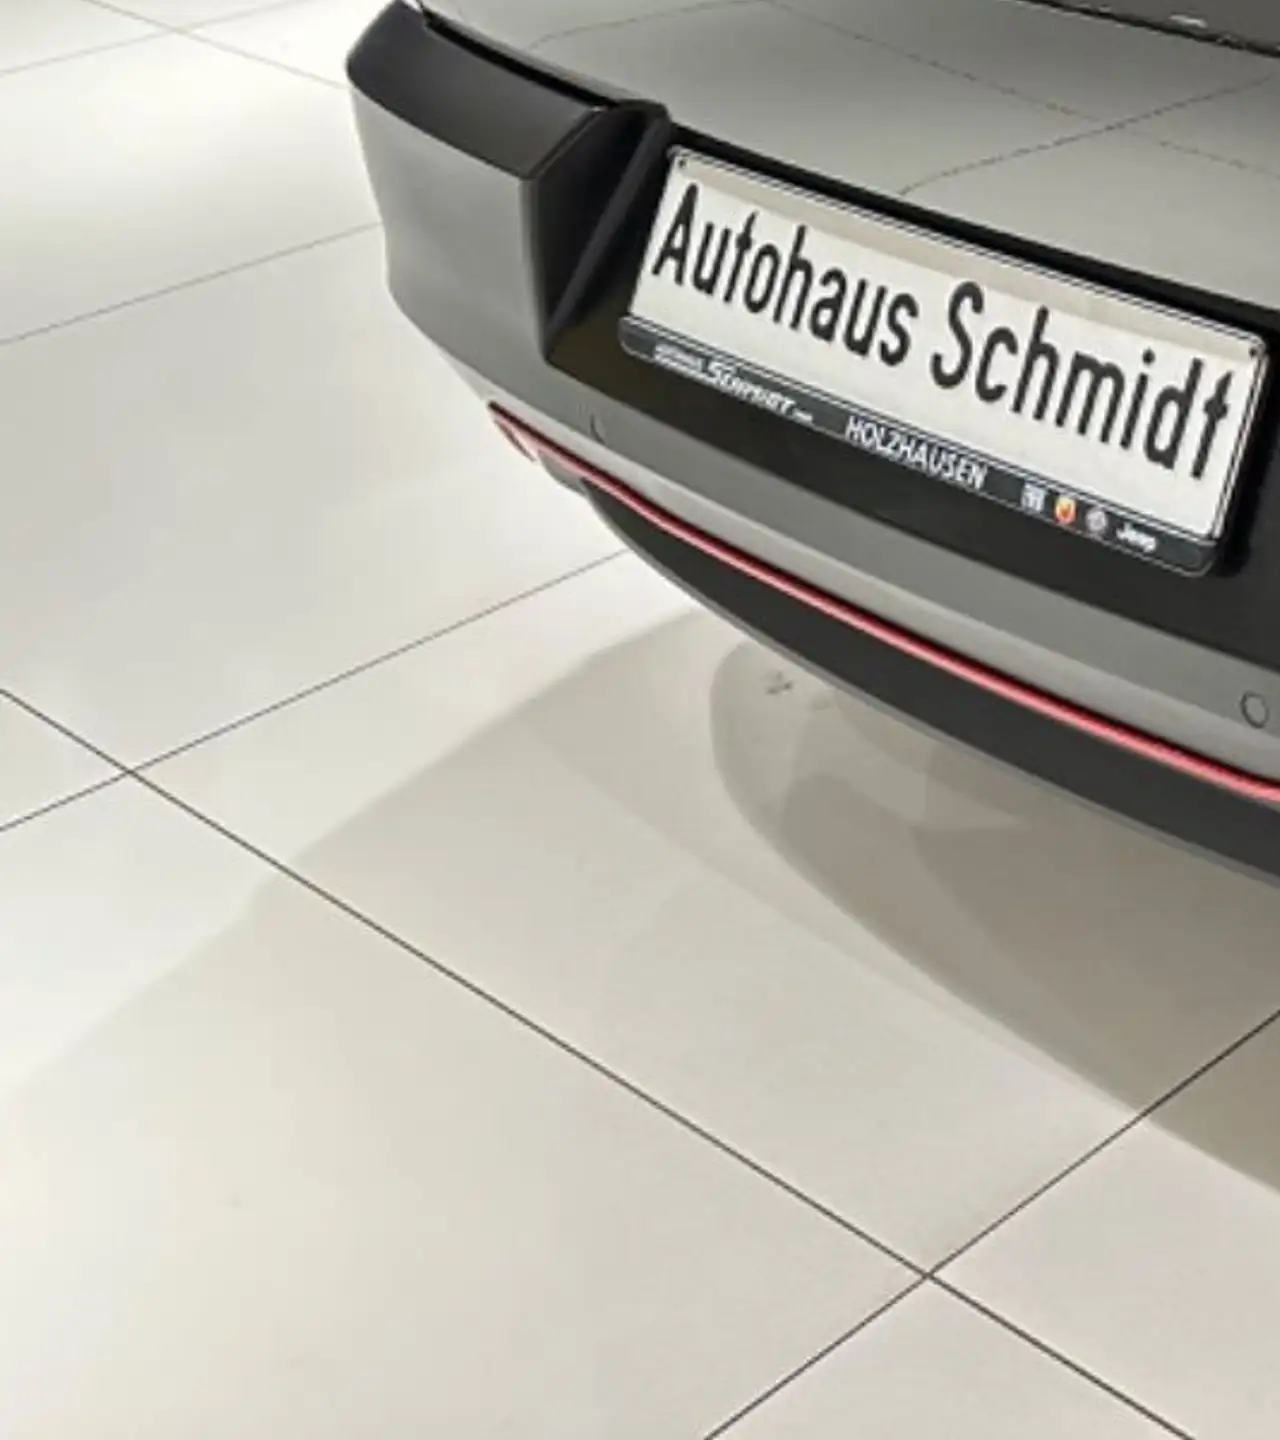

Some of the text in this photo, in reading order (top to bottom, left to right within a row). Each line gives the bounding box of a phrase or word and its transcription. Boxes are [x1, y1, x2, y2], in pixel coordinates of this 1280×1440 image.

[652, 182, 1236, 479] Autohaus Schmidt
[845, 414, 988, 491] HOLZHAUSEN
